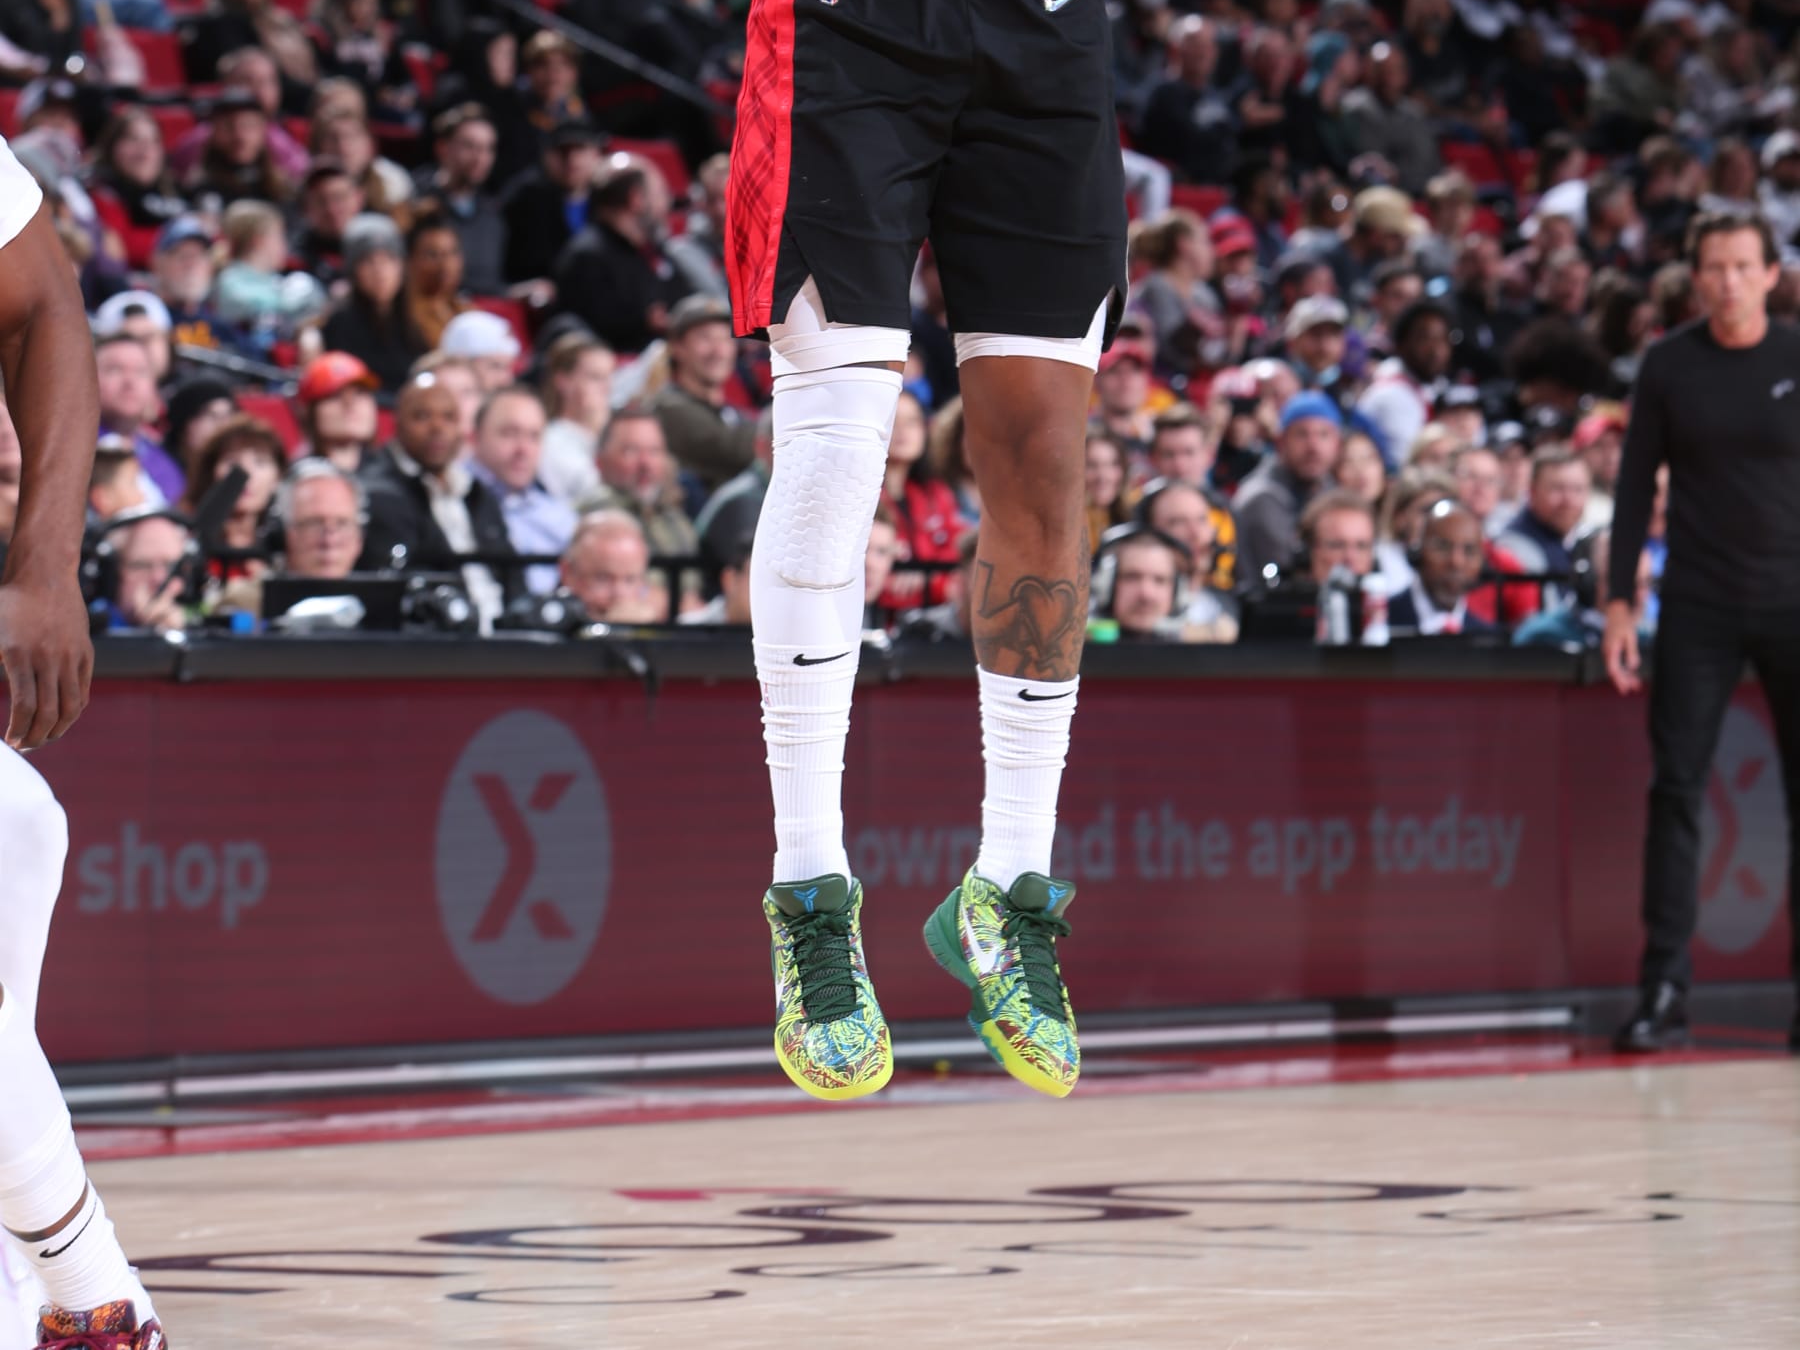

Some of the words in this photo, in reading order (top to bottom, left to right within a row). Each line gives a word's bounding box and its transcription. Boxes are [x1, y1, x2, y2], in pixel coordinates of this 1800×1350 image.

[77, 821, 269, 929] shop
[848, 800, 1117, 890] ownad
[1131, 797, 1233, 882] the
[1247, 814, 1358, 896] app
[1368, 790, 1525, 891] today
